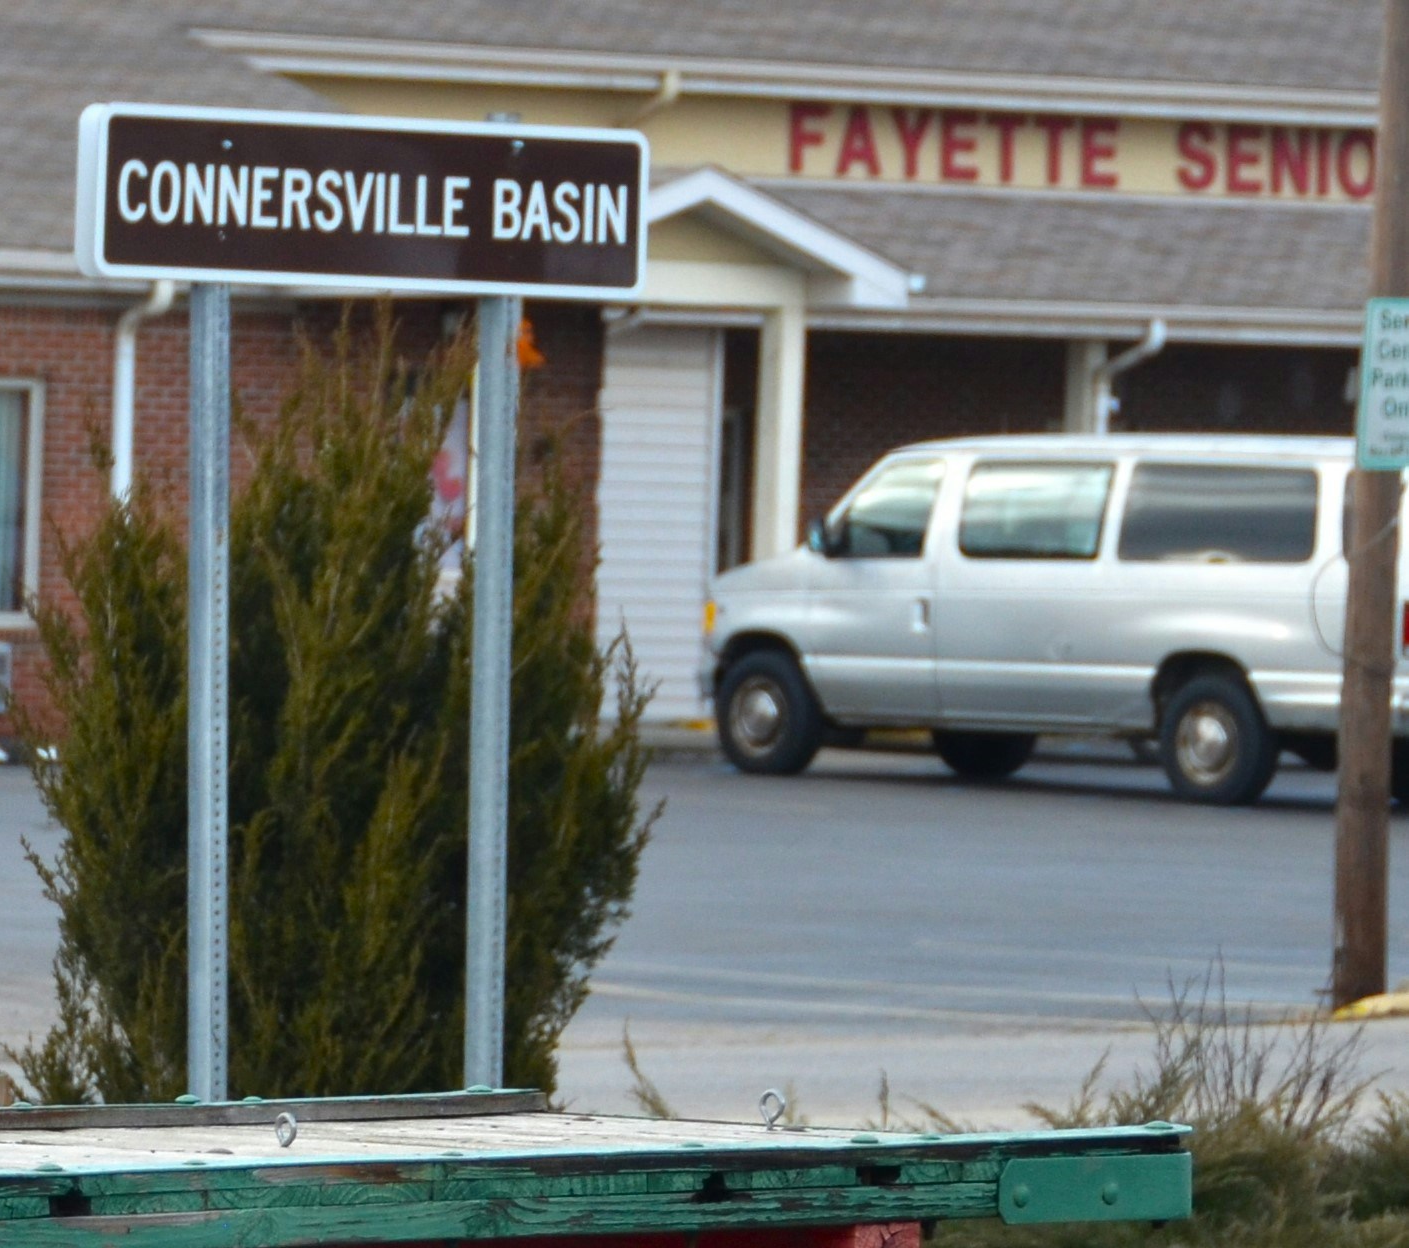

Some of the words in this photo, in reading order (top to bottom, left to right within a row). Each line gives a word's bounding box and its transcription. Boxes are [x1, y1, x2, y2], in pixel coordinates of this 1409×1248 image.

[787, 101, 1120, 189] FAYETTE
[1176, 120, 1377, 199] SENIO
[118, 158, 471, 238] CONNERSVILLE
[491, 177, 629, 246] BASIN
